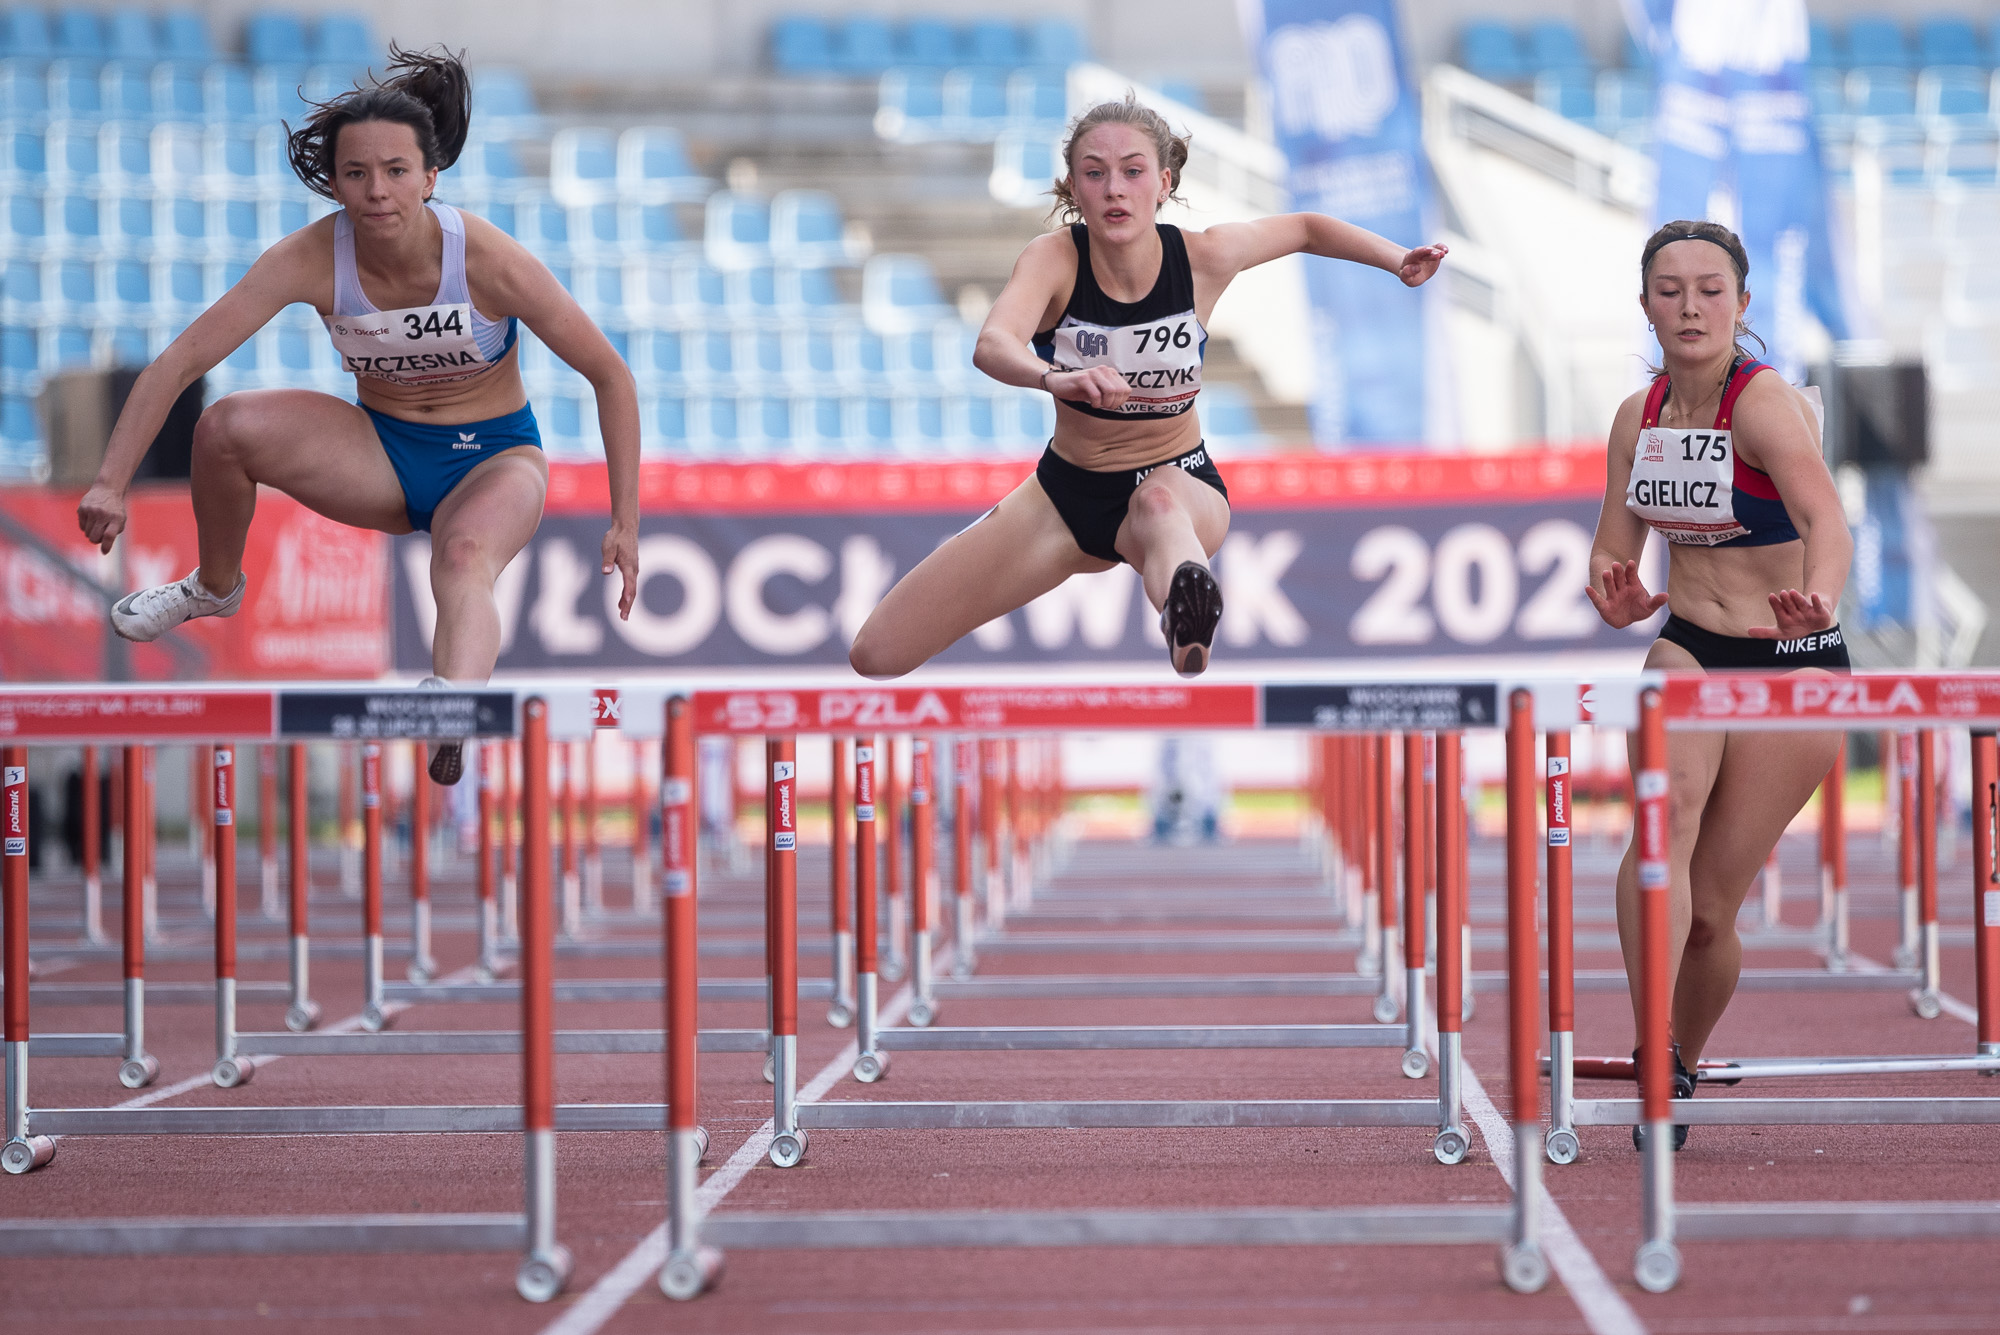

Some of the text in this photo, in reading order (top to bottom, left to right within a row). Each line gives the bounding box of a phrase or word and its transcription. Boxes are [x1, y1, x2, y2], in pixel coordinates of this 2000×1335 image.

[403, 309, 463, 340] 344
[1133, 322, 1191, 354] 796
[347, 350, 479, 374] SZCZĘSNA
[1119, 365, 1194, 389] ZCZYK
[1180, 450, 1206, 471] PRO
[1681, 434, 1726, 462] 175
[1635, 479, 1719, 508] GIELICZ
[400, 528, 1310, 653] WŁOCŁWK
[1775, 630, 1842, 655] NIKE PRO
[819, 689, 949, 726] PZLA
[1791, 679, 1923, 713] PZLA
[11, 789, 22, 833] polanik
[781, 784, 792, 828] polanik
[1555, 780, 1566, 824] polanik
